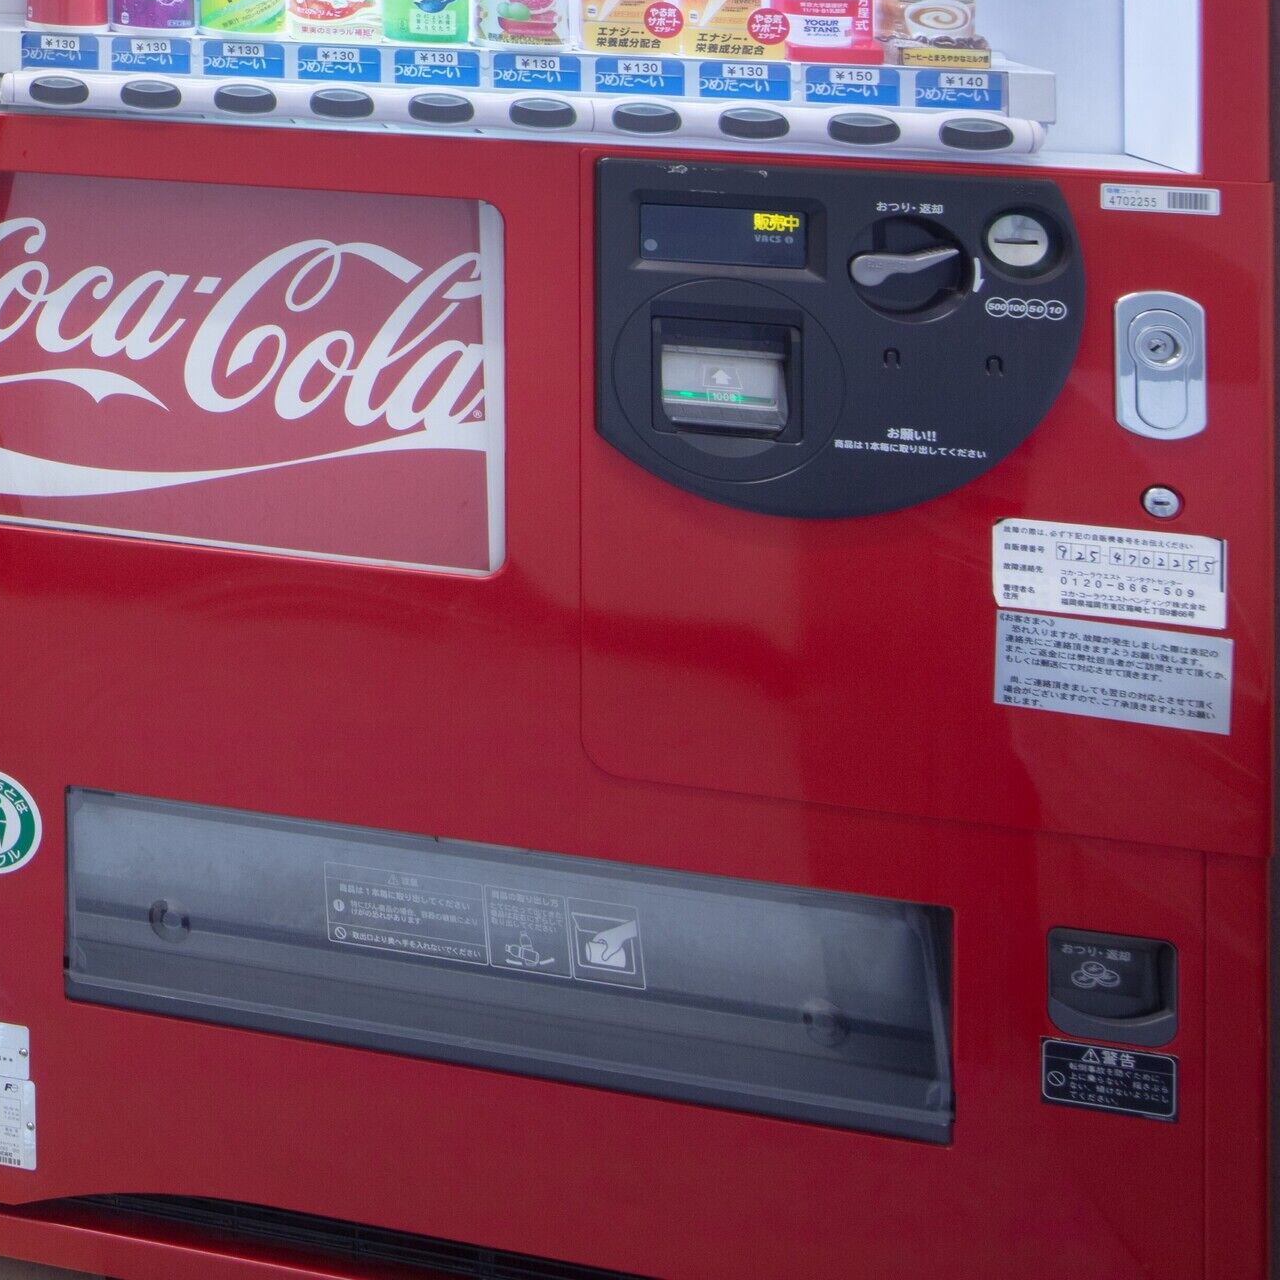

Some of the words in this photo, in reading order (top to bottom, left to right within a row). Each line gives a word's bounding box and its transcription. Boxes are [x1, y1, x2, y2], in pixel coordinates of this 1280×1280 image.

[649, 7, 678, 17] やる気
[648, 16, 681, 27] サポート
[136, 41, 168, 52] ¥130
[596, 38, 662, 49] 栄養成分配合
[419, 53, 454, 63] ¥130
[727, 66, 763, 77] ¥130
[836, 71, 873, 82] ¥150
[946, 76, 983, 87] ¥140
[1108, 194, 1158, 209] 4702255
[876, 200, 944, 217] おつり・返却
[753, 212, 800, 233] 販売中
[1003, 541, 1045, 554] 自販機番号
[1061, 943, 1132, 962] おつり・返却
[1101, 1048, 1136, 1069] 警告
